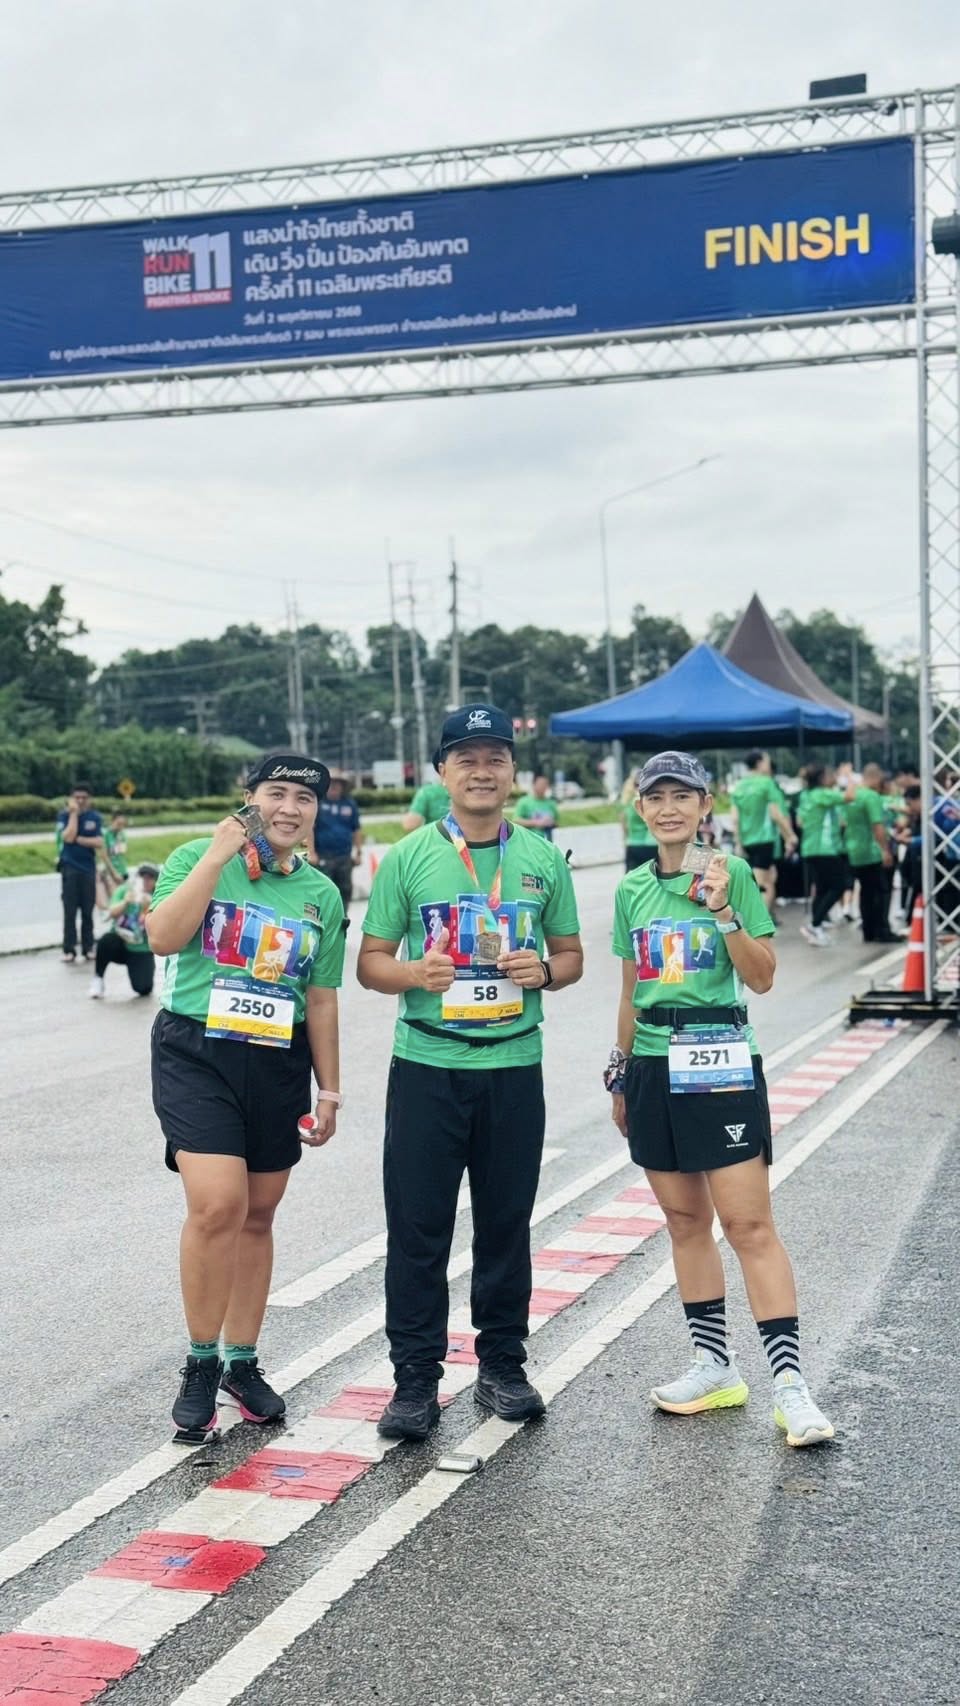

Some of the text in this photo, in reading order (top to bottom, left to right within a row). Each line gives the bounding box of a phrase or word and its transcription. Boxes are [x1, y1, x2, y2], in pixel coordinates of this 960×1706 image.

[243, 209, 415, 246] แสงนำใจไทยทั้งชาติ
[143, 235, 188, 253] WALK
[705, 213, 870, 269] FINISH
[144, 252, 190, 275] RUN
[187, 231, 232, 291] 11
[244, 237, 469, 274] เดิน วิ่ง ปั่น ป้องกันอัมพาต
[144, 273, 191, 296] BIKE
[245, 264, 453, 302] ครั้งที่ 11 เฉลิมพระเกียรติ
[474, 985, 498, 1001] 58
[228, 996, 275, 1018] 2550
[689, 1049, 729, 1066] 2571
